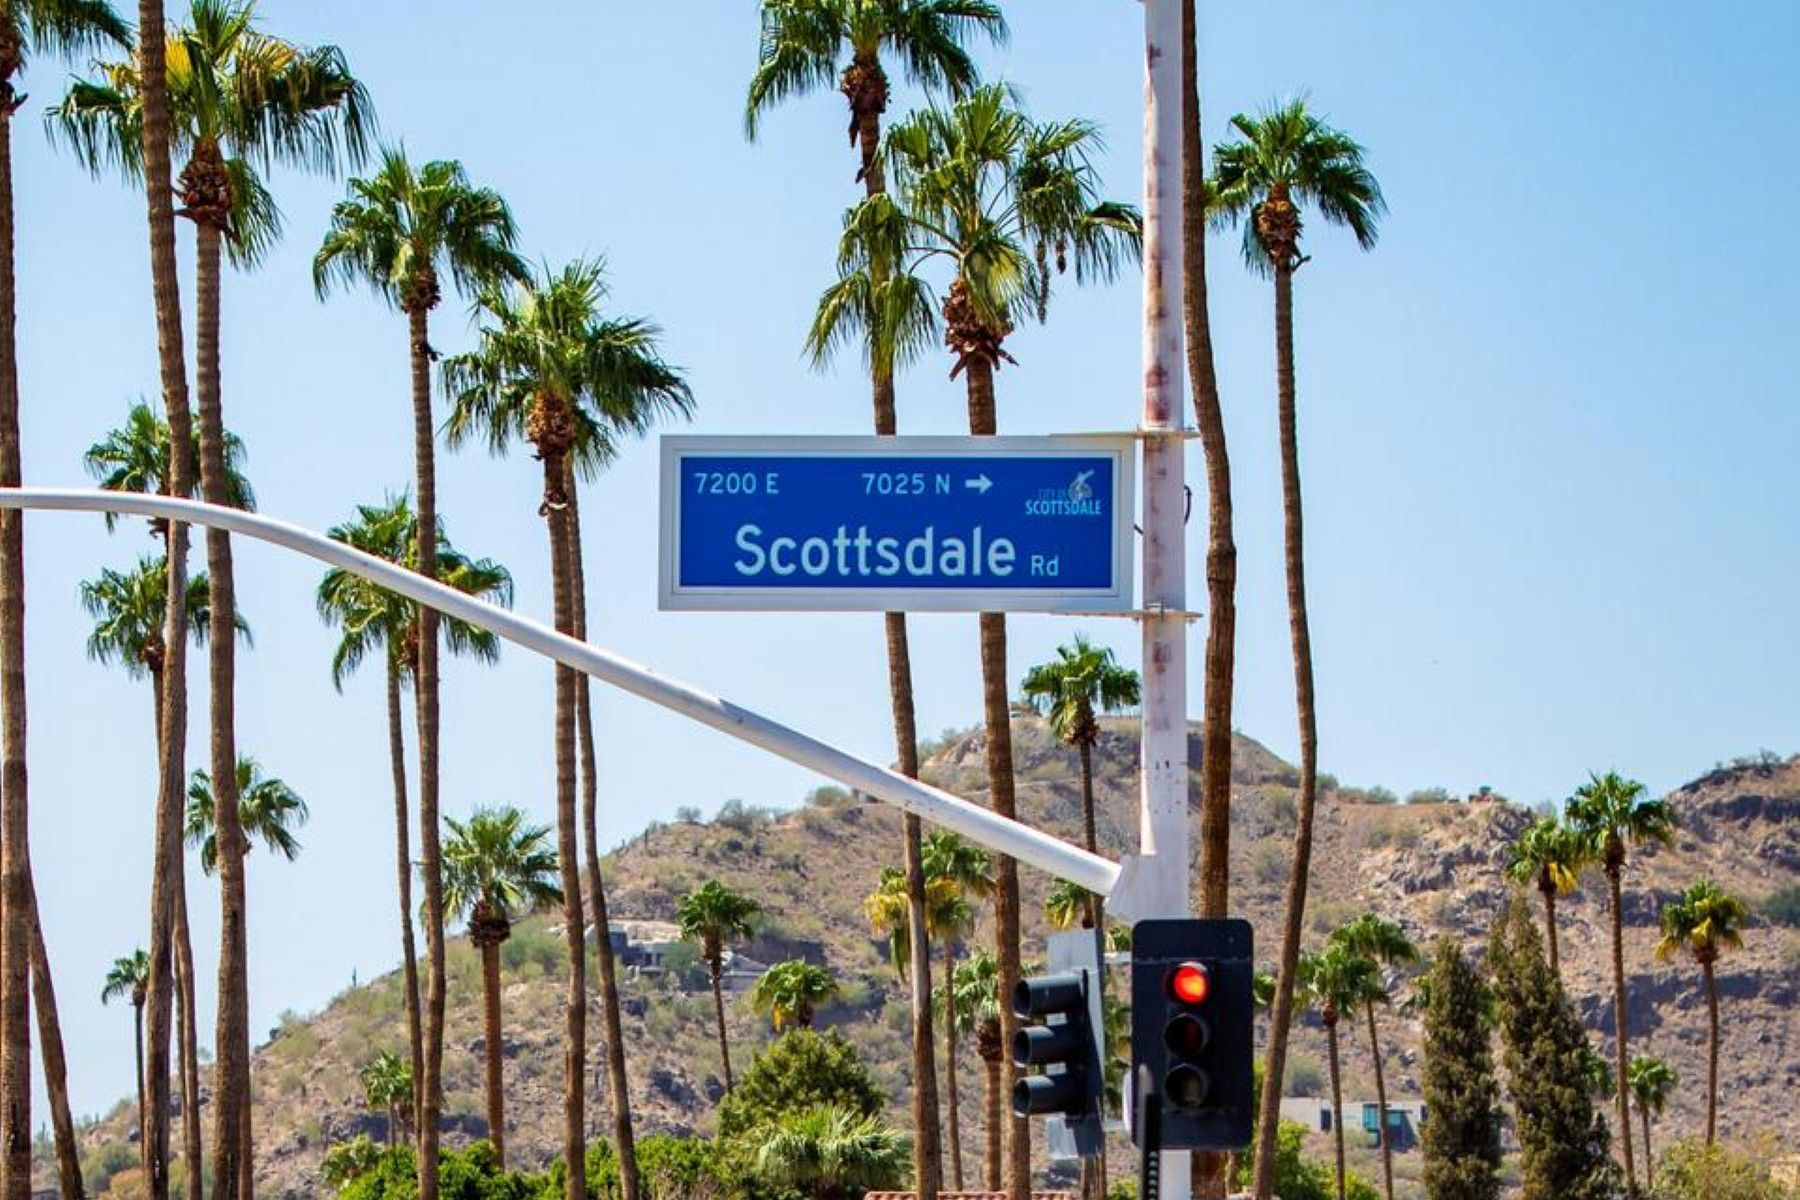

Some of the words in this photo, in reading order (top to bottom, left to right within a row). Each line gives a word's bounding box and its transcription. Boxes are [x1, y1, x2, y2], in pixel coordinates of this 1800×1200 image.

[694, 472, 757, 495] 7200
[766, 472, 779, 495] E
[861, 472, 926, 495] 7025
[935, 473, 950, 495] N
[1025, 499, 1101, 515] SCOTTSDALE
[734, 523, 1016, 577] Scottsdale
[1031, 554, 1059, 577] Rd
